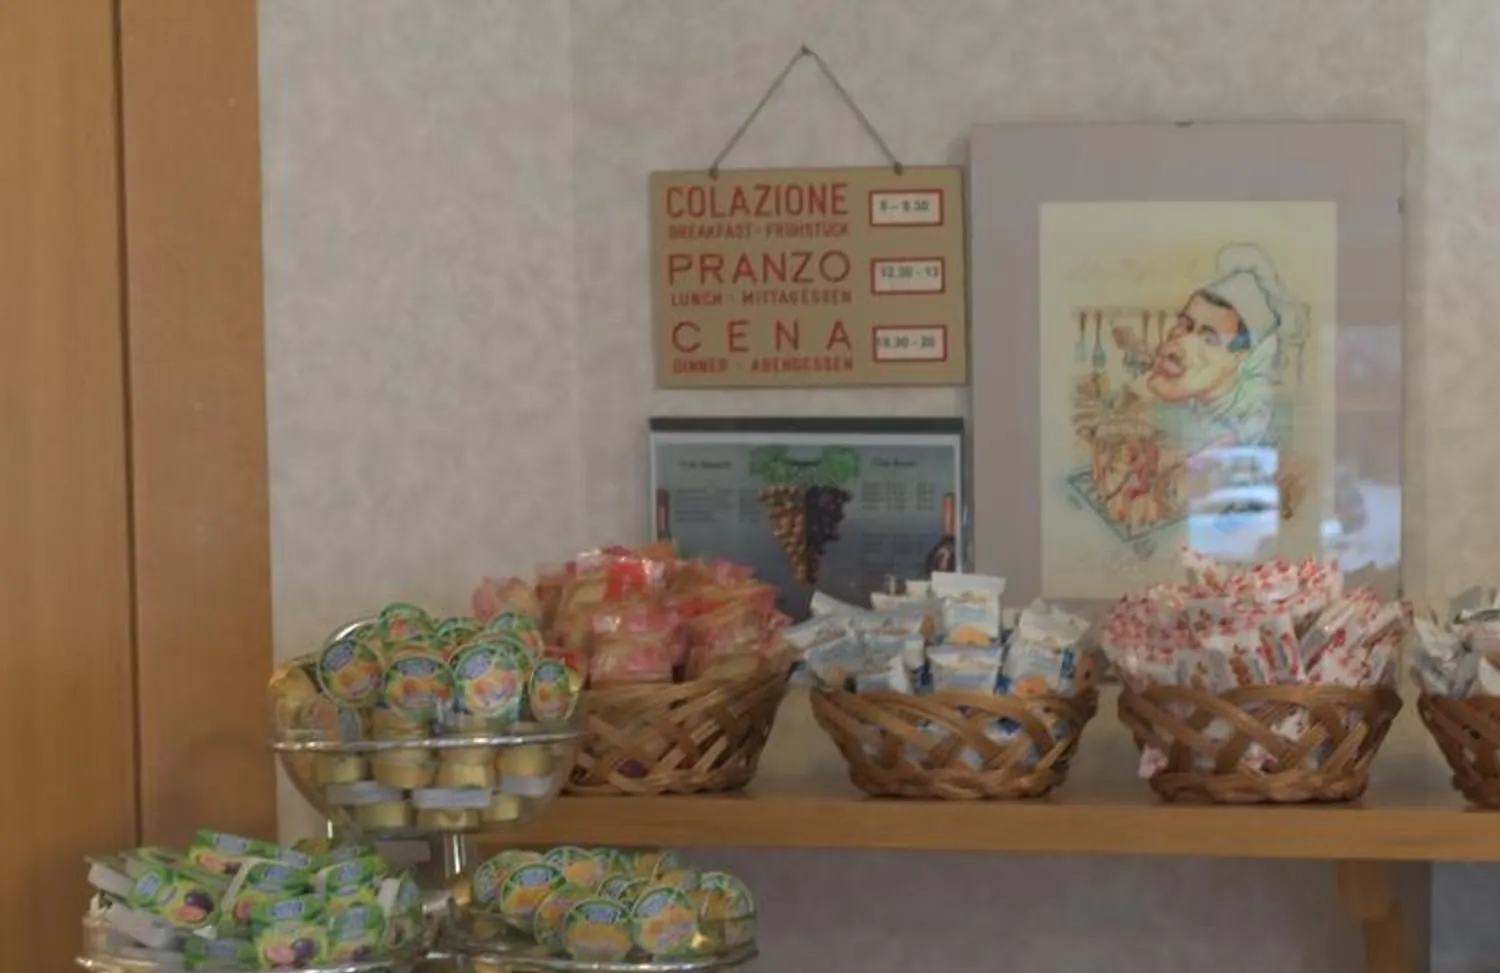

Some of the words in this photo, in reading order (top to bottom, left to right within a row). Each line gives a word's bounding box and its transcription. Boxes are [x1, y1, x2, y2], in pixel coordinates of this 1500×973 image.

[666, 184, 848, 218] COLAZIONE
[668, 250, 851, 285] PRANZO
[672, 319, 852, 353] CENA
